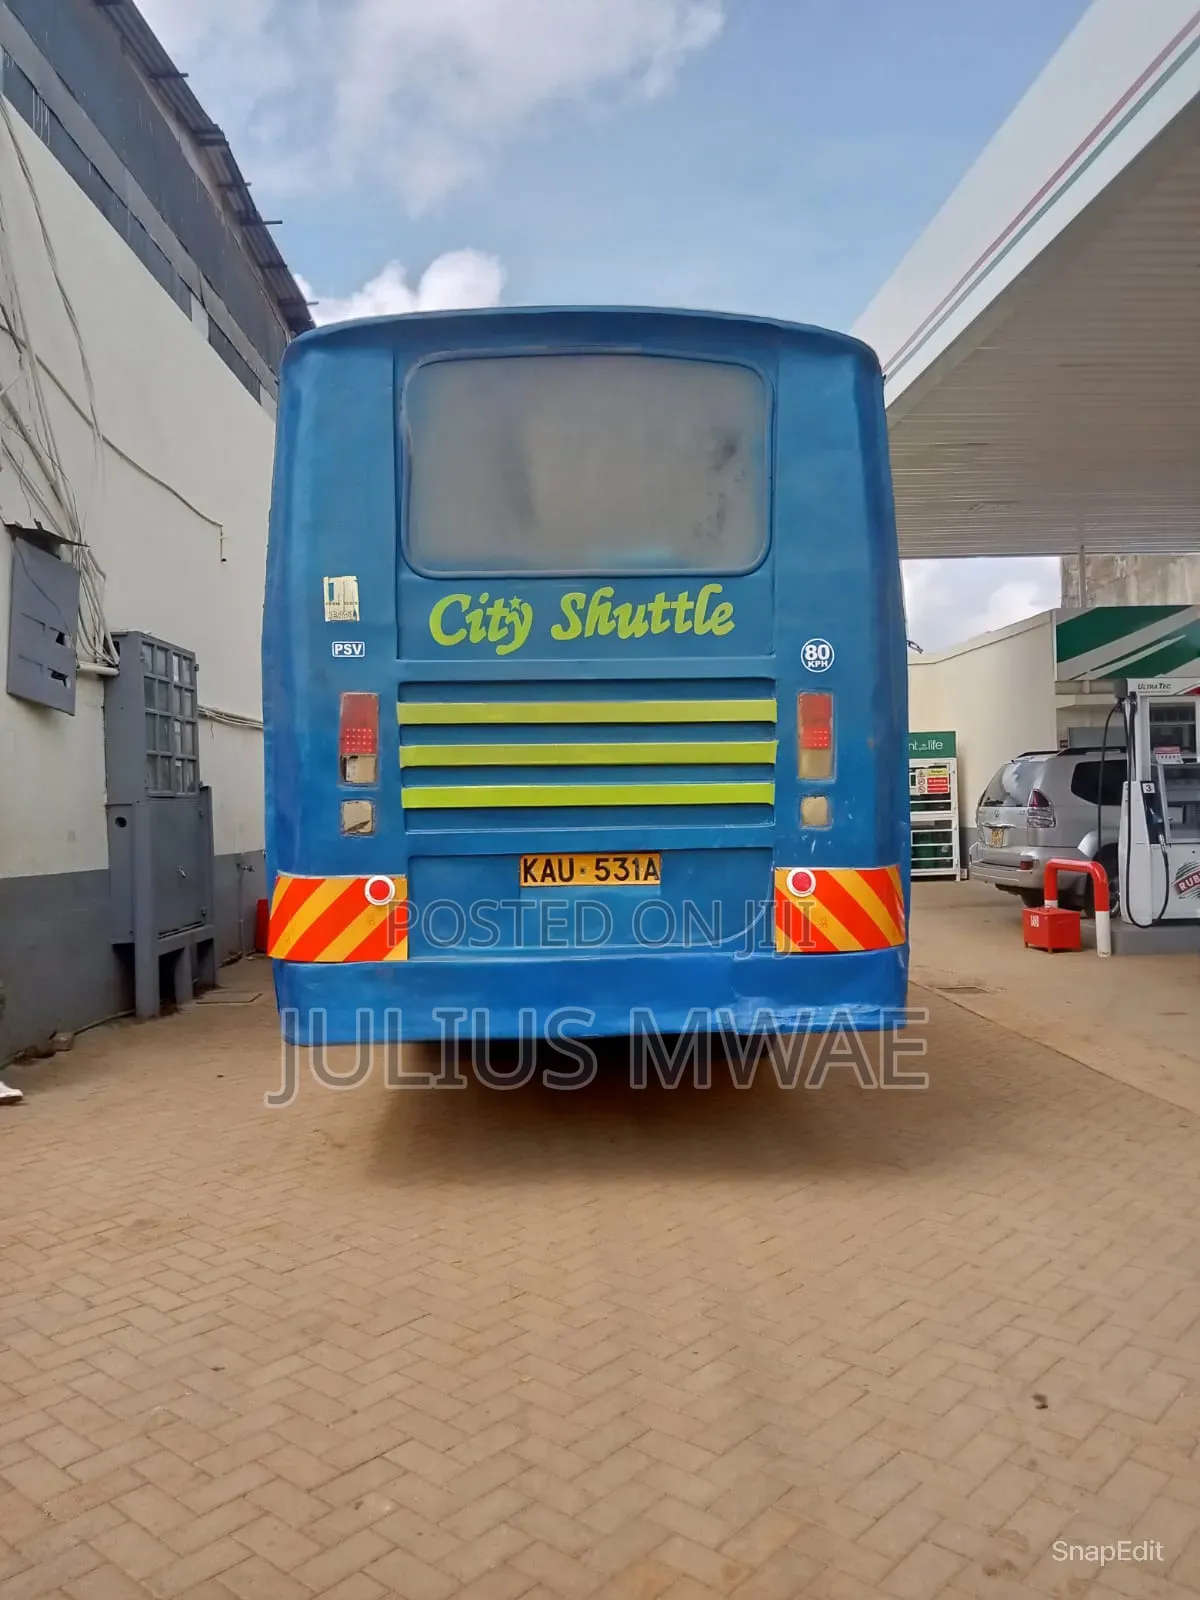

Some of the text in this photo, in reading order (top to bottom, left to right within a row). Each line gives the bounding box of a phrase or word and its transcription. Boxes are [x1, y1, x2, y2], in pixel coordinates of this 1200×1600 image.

[429, 583, 735, 655] City Shuttle
[334, 643, 362, 655] PSV
[805, 644, 830, 660] 80
[808, 660, 828, 668] KPH
[928, 739, 944, 750] life
[1145, 784, 1152, 792] 3
[523, 857, 660, 883] KAU 531A
